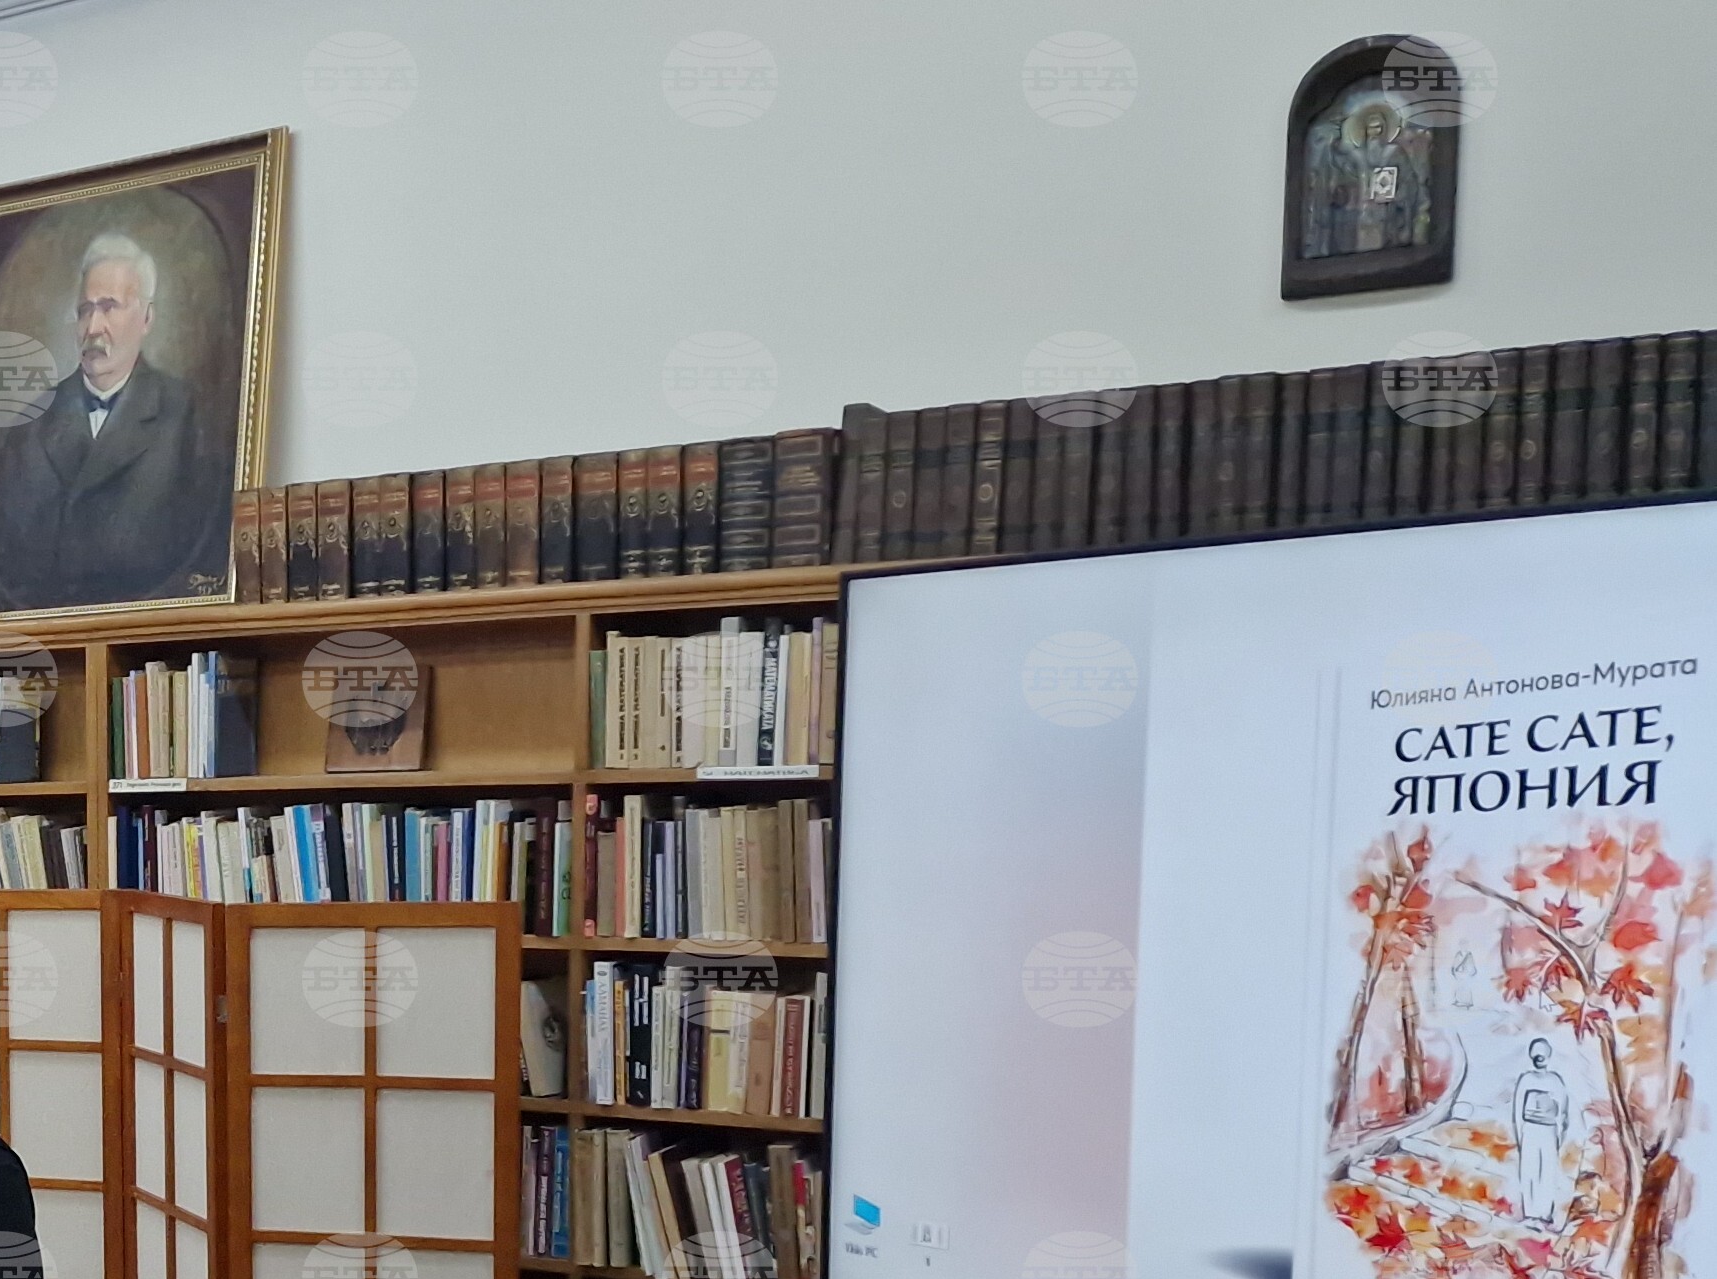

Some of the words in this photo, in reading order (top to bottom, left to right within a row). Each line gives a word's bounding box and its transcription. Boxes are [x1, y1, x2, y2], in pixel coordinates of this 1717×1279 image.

[761, 656, 779, 730] МАТЕМАТИКАТА
[1370, 684, 1457, 710] Юлияна
[1464, 658, 1698, 701] Антонова-Мурата
[1394, 719, 1512, 763] САТЕ
[1527, 705, 1675, 752] САТЕ,
[1386, 759, 1663, 817] ЯПОНИЯ
